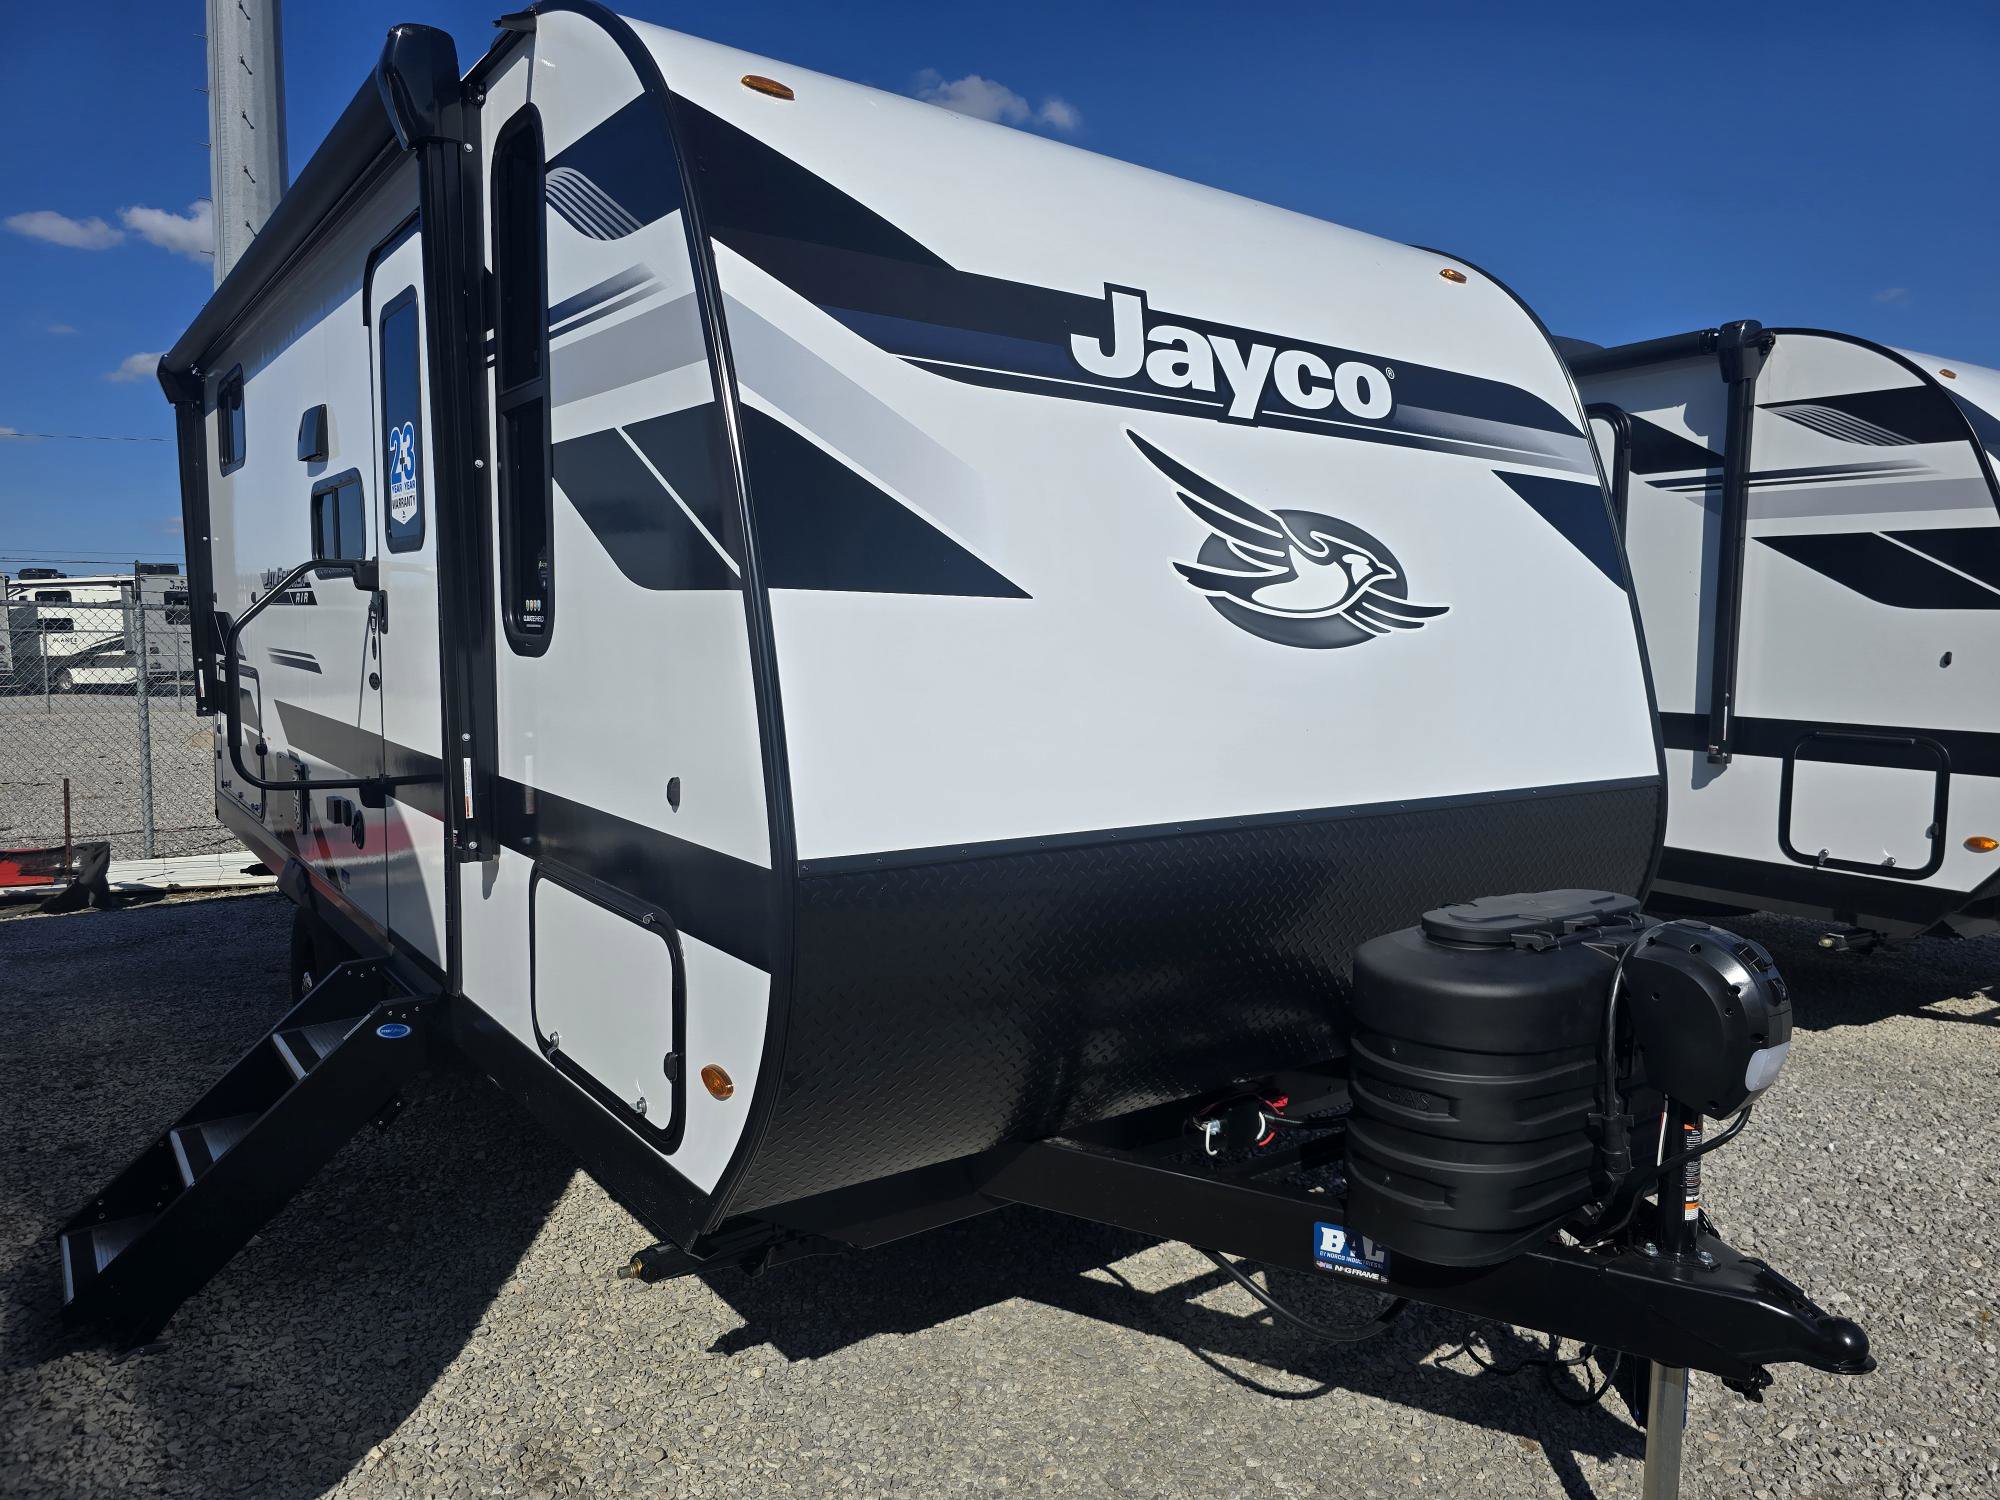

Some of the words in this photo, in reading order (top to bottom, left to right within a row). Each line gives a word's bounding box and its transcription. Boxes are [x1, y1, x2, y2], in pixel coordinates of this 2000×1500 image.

[1071, 291, 1393, 420] Jayco
[404, 480, 415, 491] YEAR
[392, 495, 416, 510] WARRANTY
[295, 592, 309, 604] AIR
[1326, 1252, 1346, 1261] NORCO
[1351, 1269, 1380, 1280] FRAME
